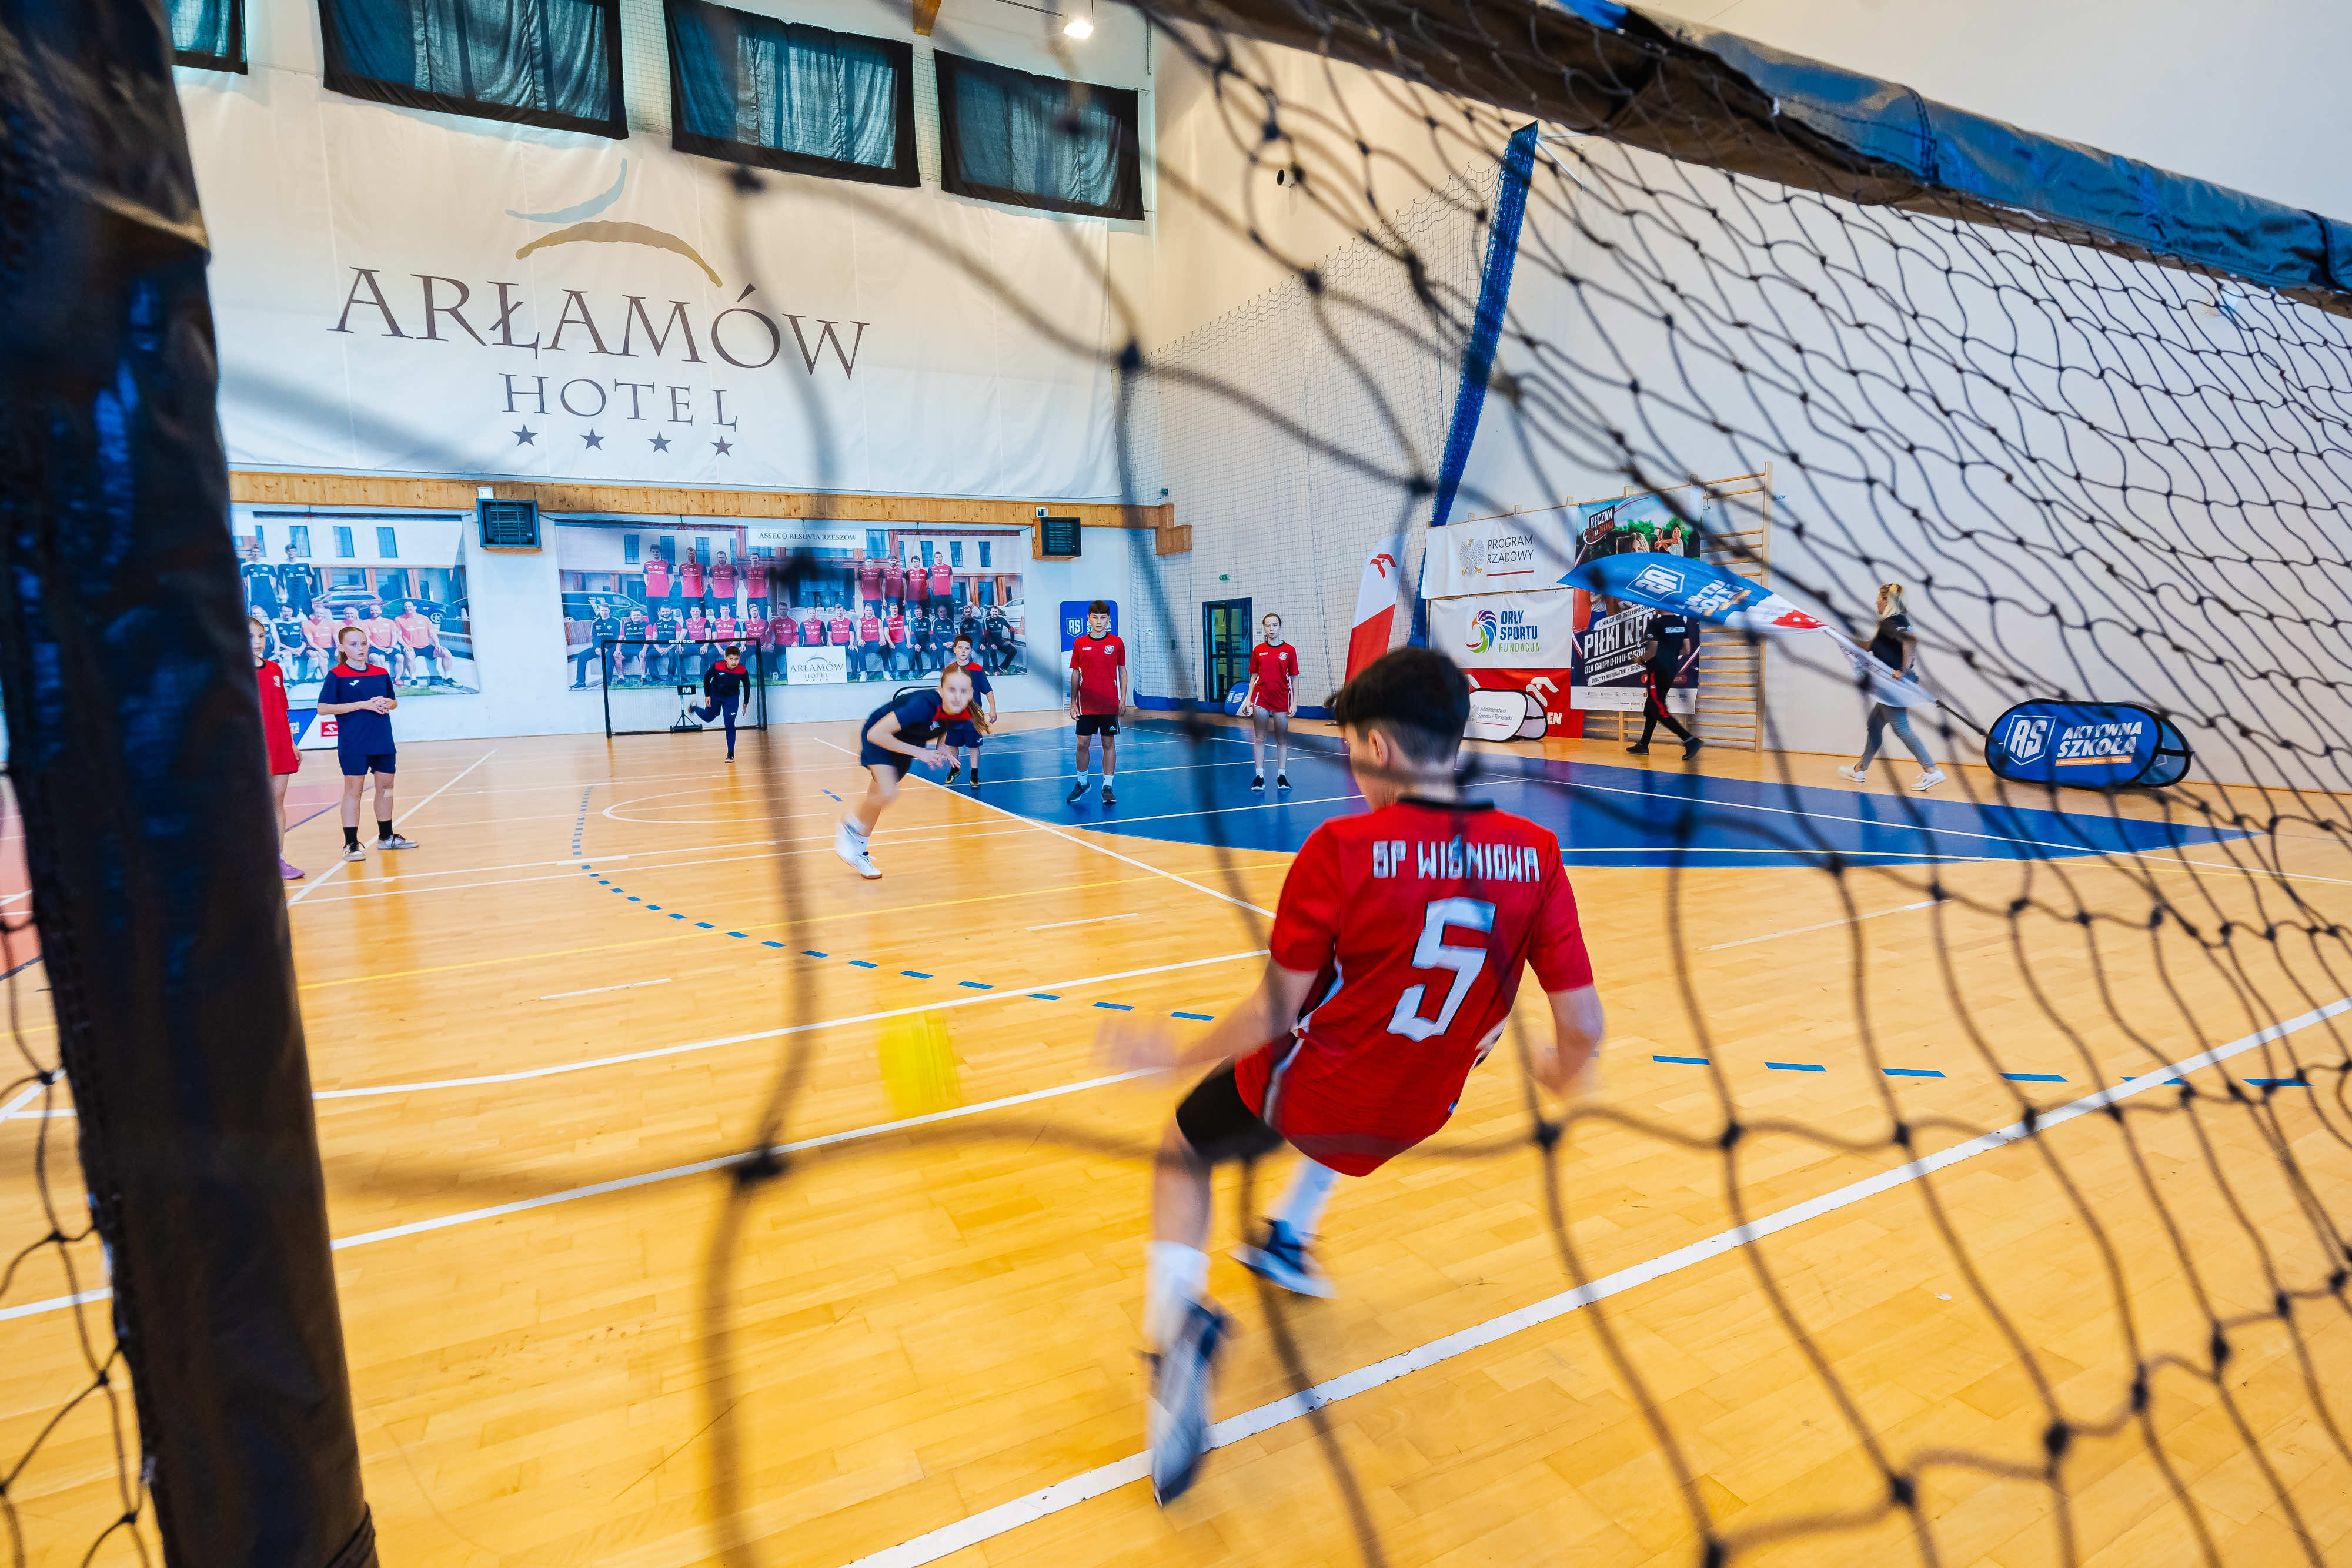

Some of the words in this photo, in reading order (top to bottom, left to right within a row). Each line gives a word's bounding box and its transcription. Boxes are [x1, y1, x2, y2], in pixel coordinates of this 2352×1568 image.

[327, 266, 870, 379] ARŁAMÓW
[499, 372, 739, 432] HOTEL
[1488, 534, 1534, 550] PROGRAM
[1487, 549, 1534, 565] RZĄDOWY
[1501, 610, 1524, 624] ORŁY
[1500, 626, 1538, 640] SPORTU
[1499, 643, 1540, 653] FUNDACJA
[1584, 624, 1620, 660] PIŁKI
[790, 661, 844, 672] ARŁAMÓW
[1585, 664, 1594, 674] DLA
[1595, 659, 1610, 671] GRUPY
[2010, 720, 2047, 758] AS
[2062, 722, 2142, 740] AKTYWNA
[2057, 736, 2137, 758] SZKOŁA
[1386, 897, 1496, 1042] 5
